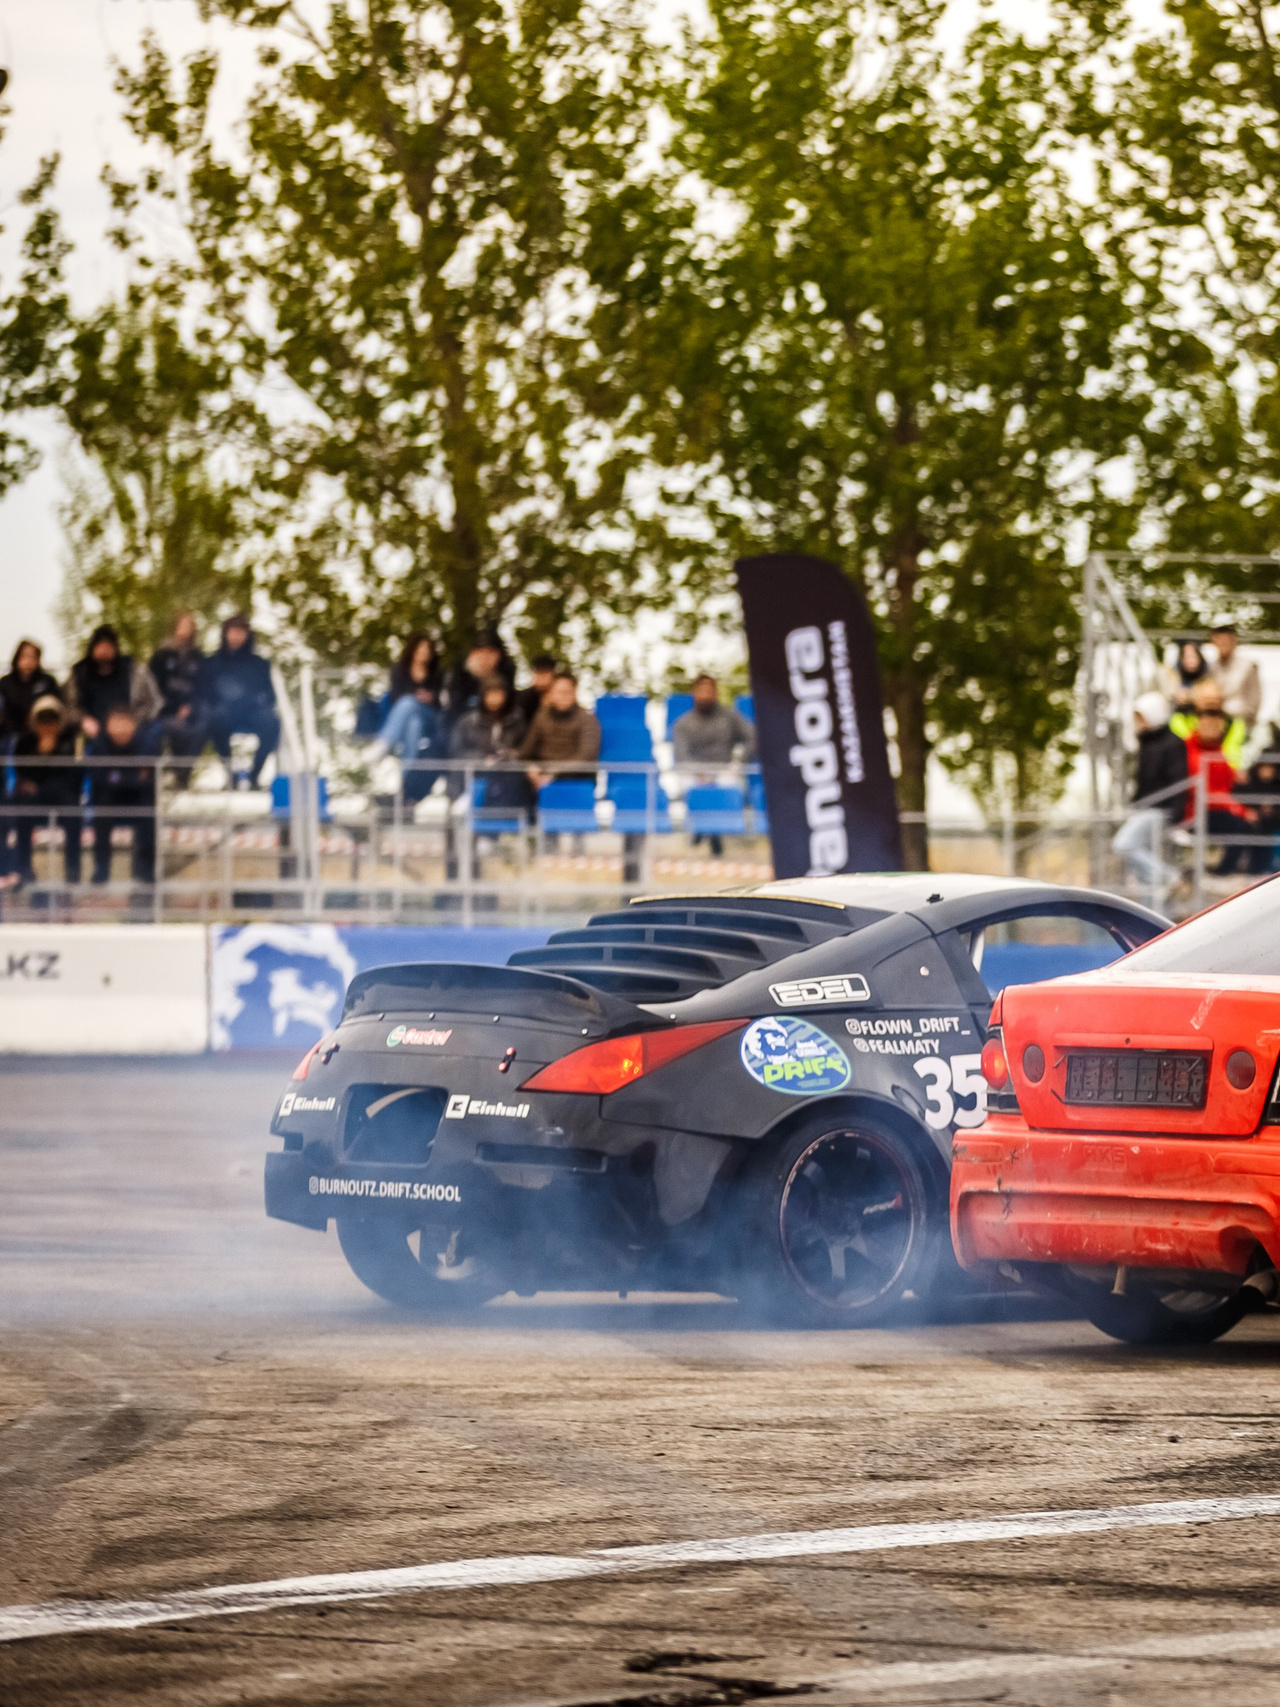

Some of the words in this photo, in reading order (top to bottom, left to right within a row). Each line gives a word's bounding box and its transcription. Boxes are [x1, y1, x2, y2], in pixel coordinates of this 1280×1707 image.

[785, 626, 848, 876] andora
[774, 979, 868, 1003] EDEL
[763, 1056, 847, 1084] DRIFT
[913, 1053, 988, 1130] 35
[467, 1100, 531, 1118] Einhell
